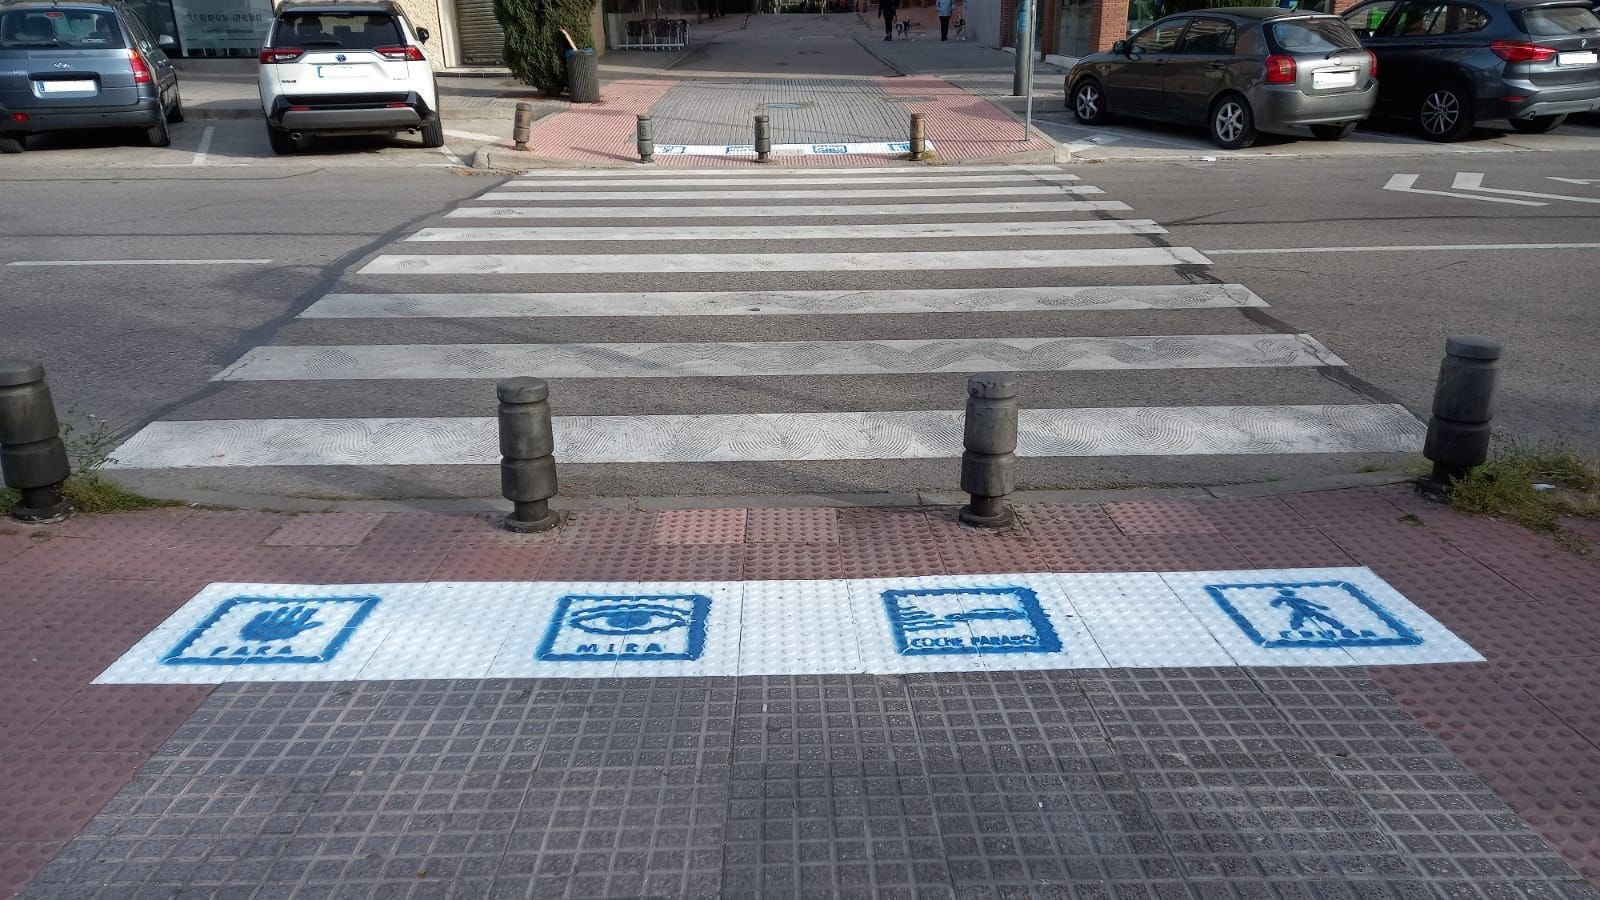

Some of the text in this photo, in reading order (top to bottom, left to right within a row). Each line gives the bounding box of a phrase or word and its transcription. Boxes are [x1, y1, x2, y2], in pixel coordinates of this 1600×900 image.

[911, 634, 1038, 647] COCHE PARADO
[209, 646, 292, 656] PARA
[576, 643, 662, 652] MIRA
